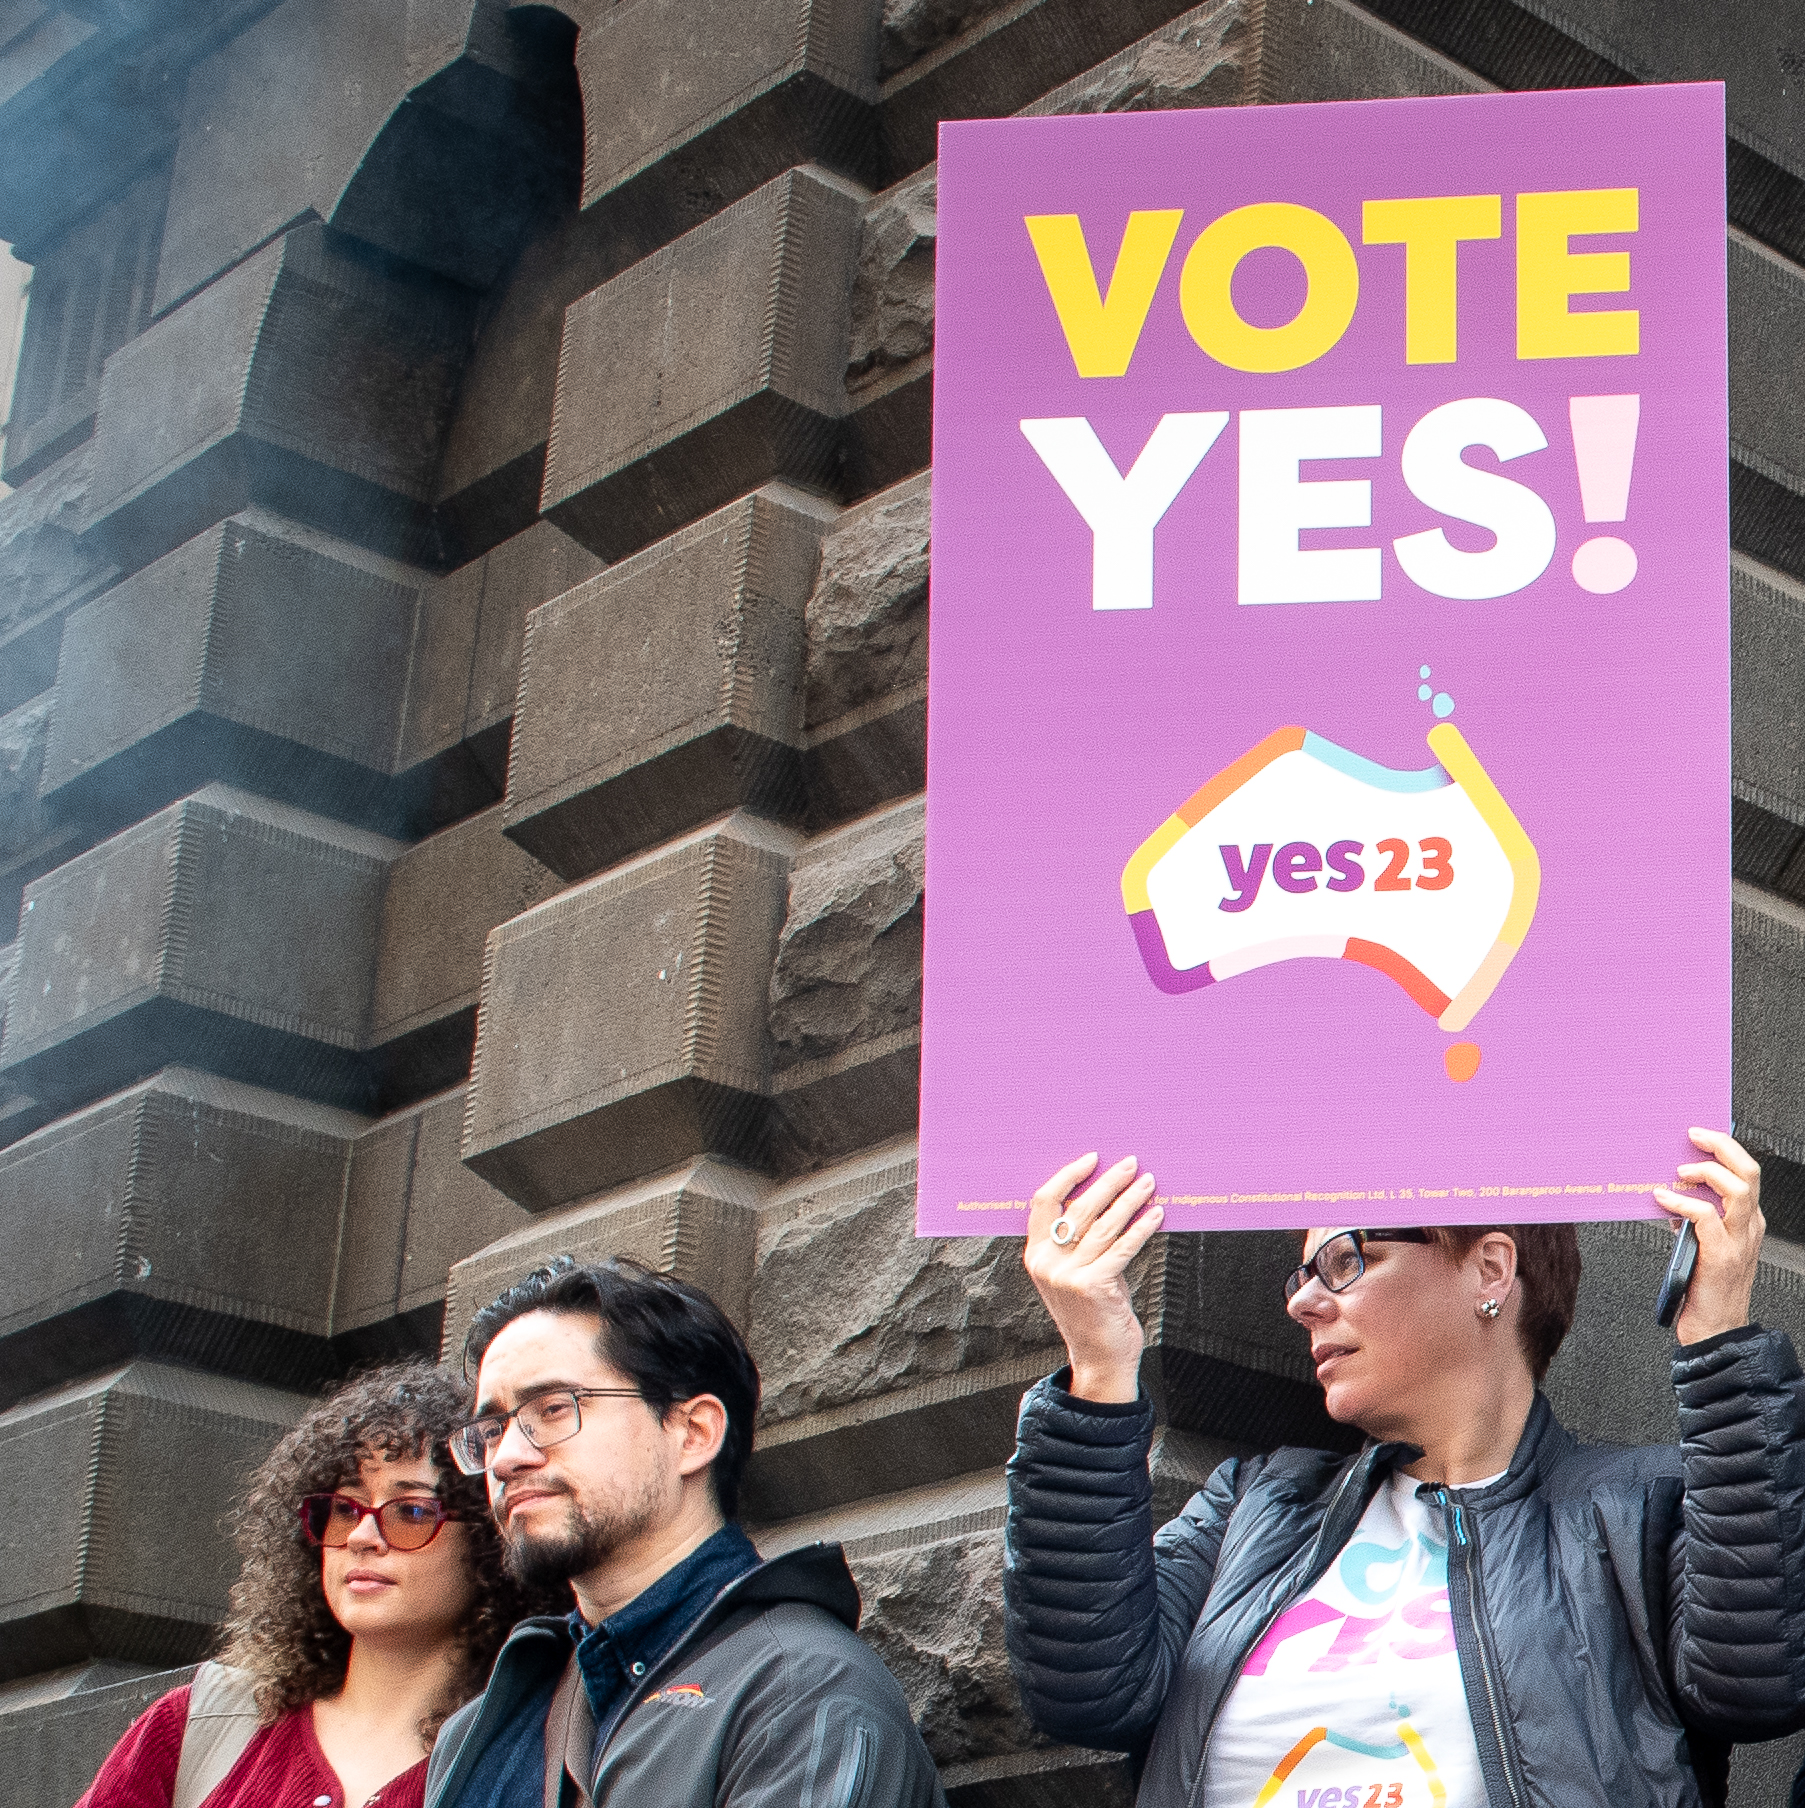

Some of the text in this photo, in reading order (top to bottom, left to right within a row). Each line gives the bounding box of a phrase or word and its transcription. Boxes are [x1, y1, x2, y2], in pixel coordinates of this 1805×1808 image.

[1024, 187, 1640, 379] VOTE
[1019, 393, 1641, 612] YES!
[1217, 836, 1455, 913] yes23
